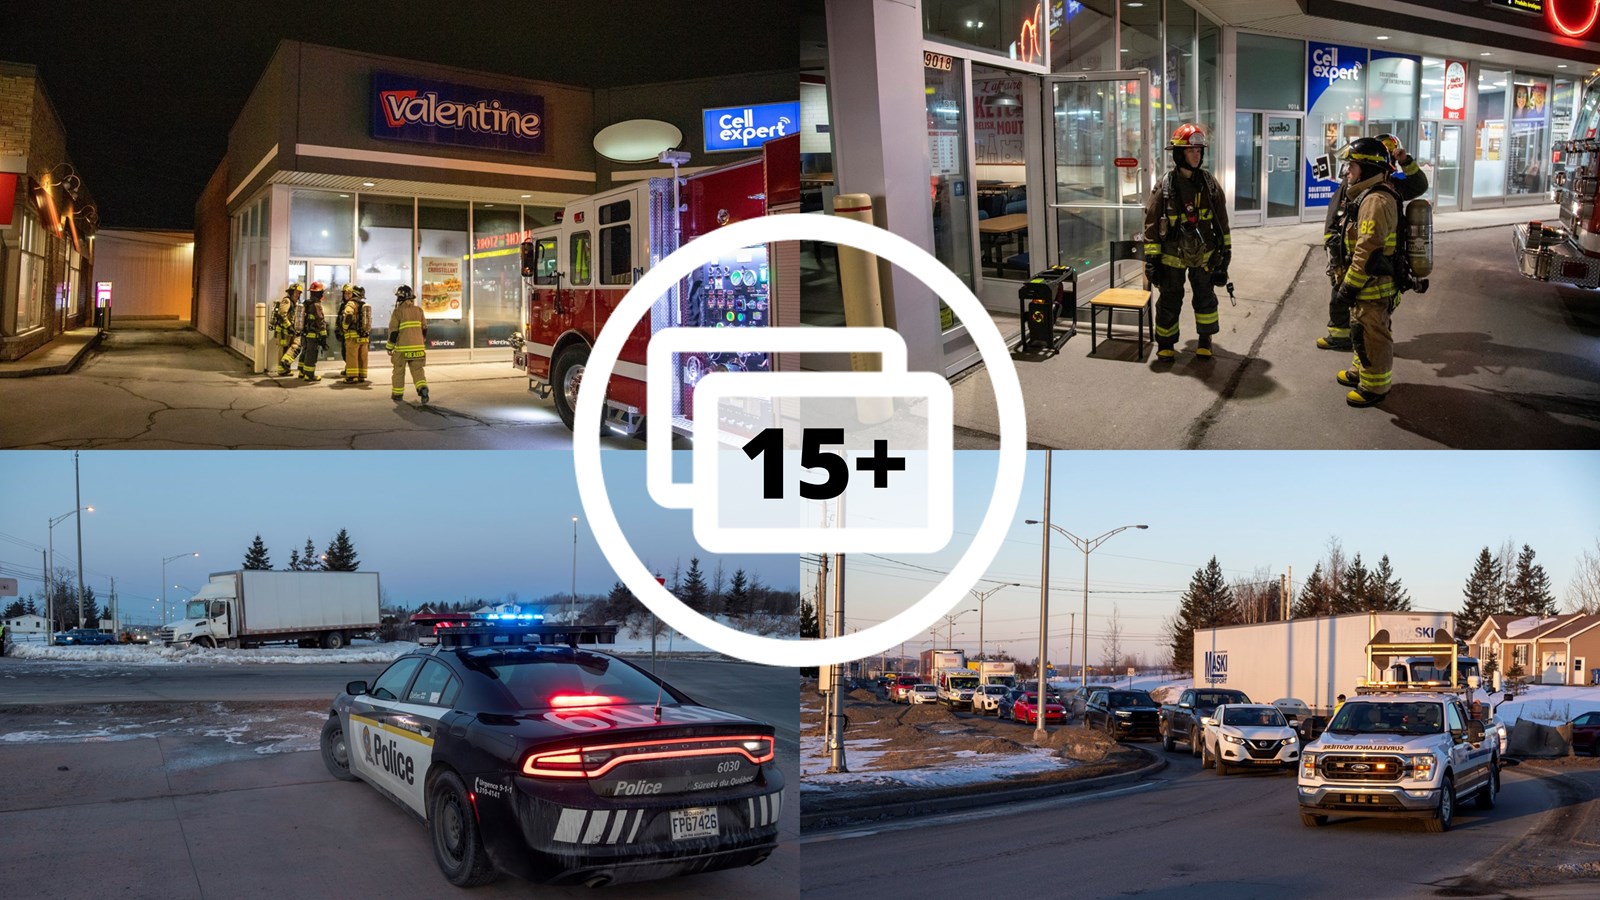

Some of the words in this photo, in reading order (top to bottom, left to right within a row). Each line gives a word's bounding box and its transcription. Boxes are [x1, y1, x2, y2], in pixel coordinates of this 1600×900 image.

[925, 53, 952, 69] 9018
[1313, 47, 1338, 66] Cell
[1312, 64, 1359, 85] expert
[719, 109, 753, 129] Cell
[720, 122, 785, 146] expert
[1361, 220, 1375, 234] 82
[1205, 651, 1227, 677] MASKI
[374, 733, 414, 785] Police
[717, 760, 740, 773] 6030
[500, 784, 512, 794] 9-1-1
[614, 780, 662, 796] Police
[693, 779, 718, 790] Sûreté
[720, 779, 730, 787] du
[731, 775, 754, 785] Québec
[673, 814, 716, 833] FPG7426
